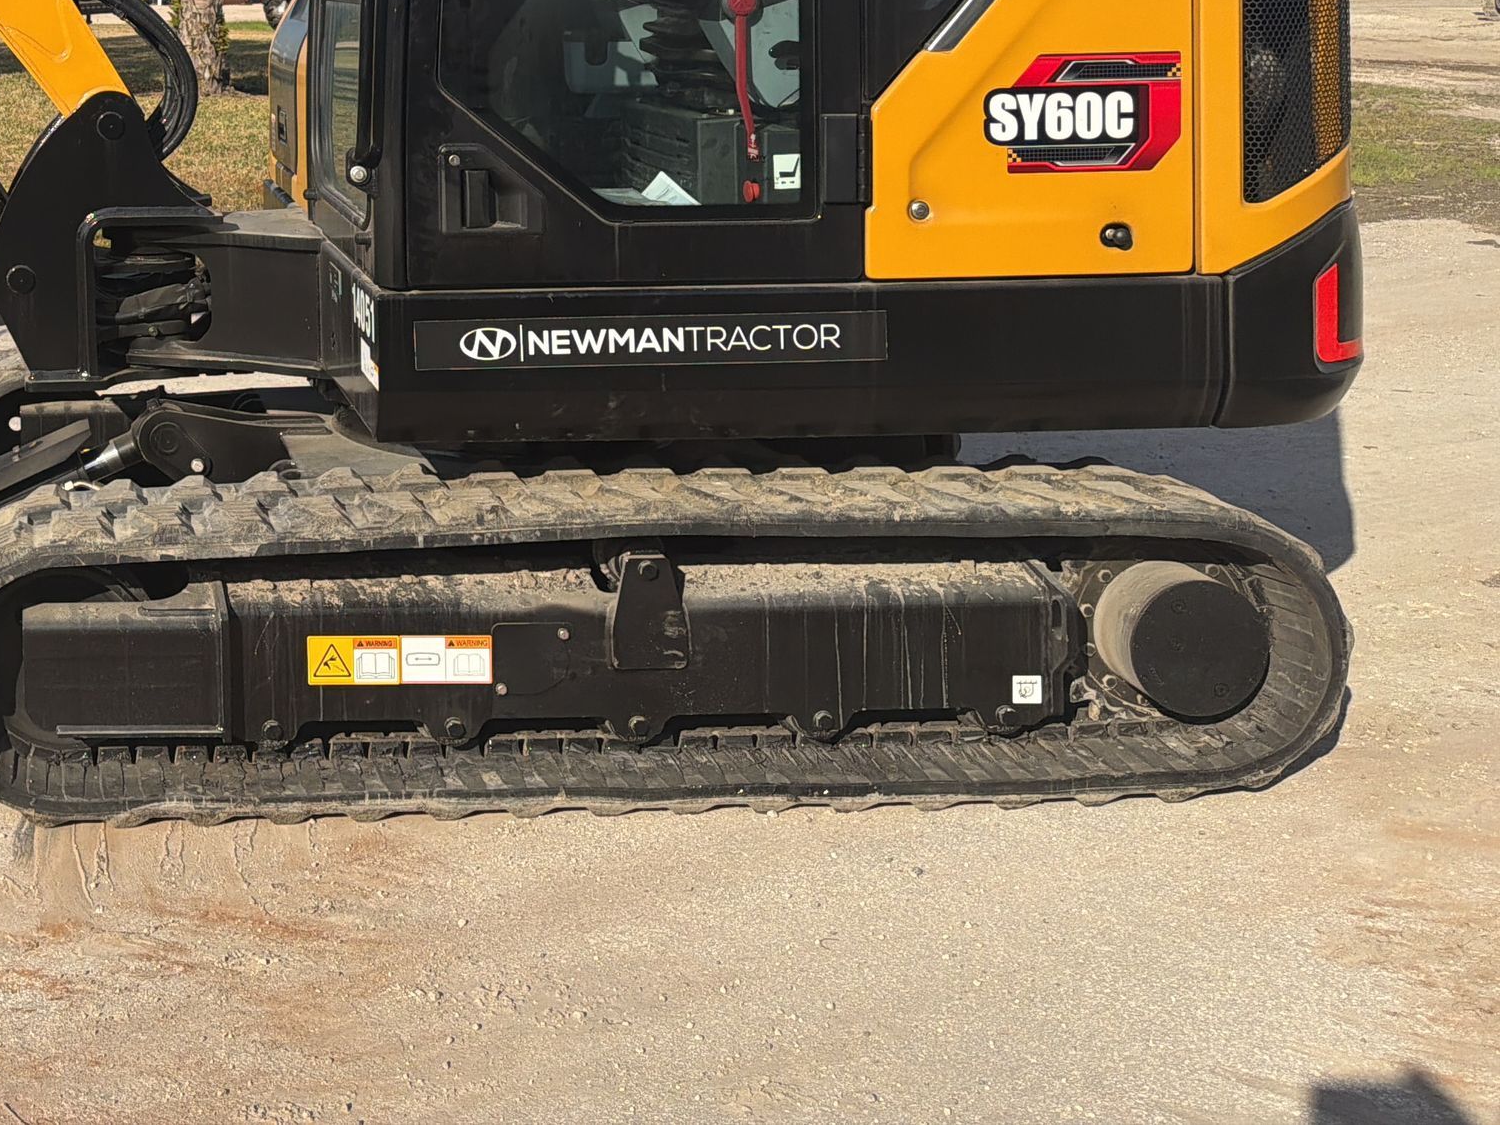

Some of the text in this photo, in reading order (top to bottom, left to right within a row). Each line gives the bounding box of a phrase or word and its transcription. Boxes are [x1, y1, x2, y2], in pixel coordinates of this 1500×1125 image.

[988, 90, 1135, 142] SY60C
[351, 282, 376, 344] 14051
[365, 639, 393, 648] WARNING
[456, 639, 488, 647] WARNING
